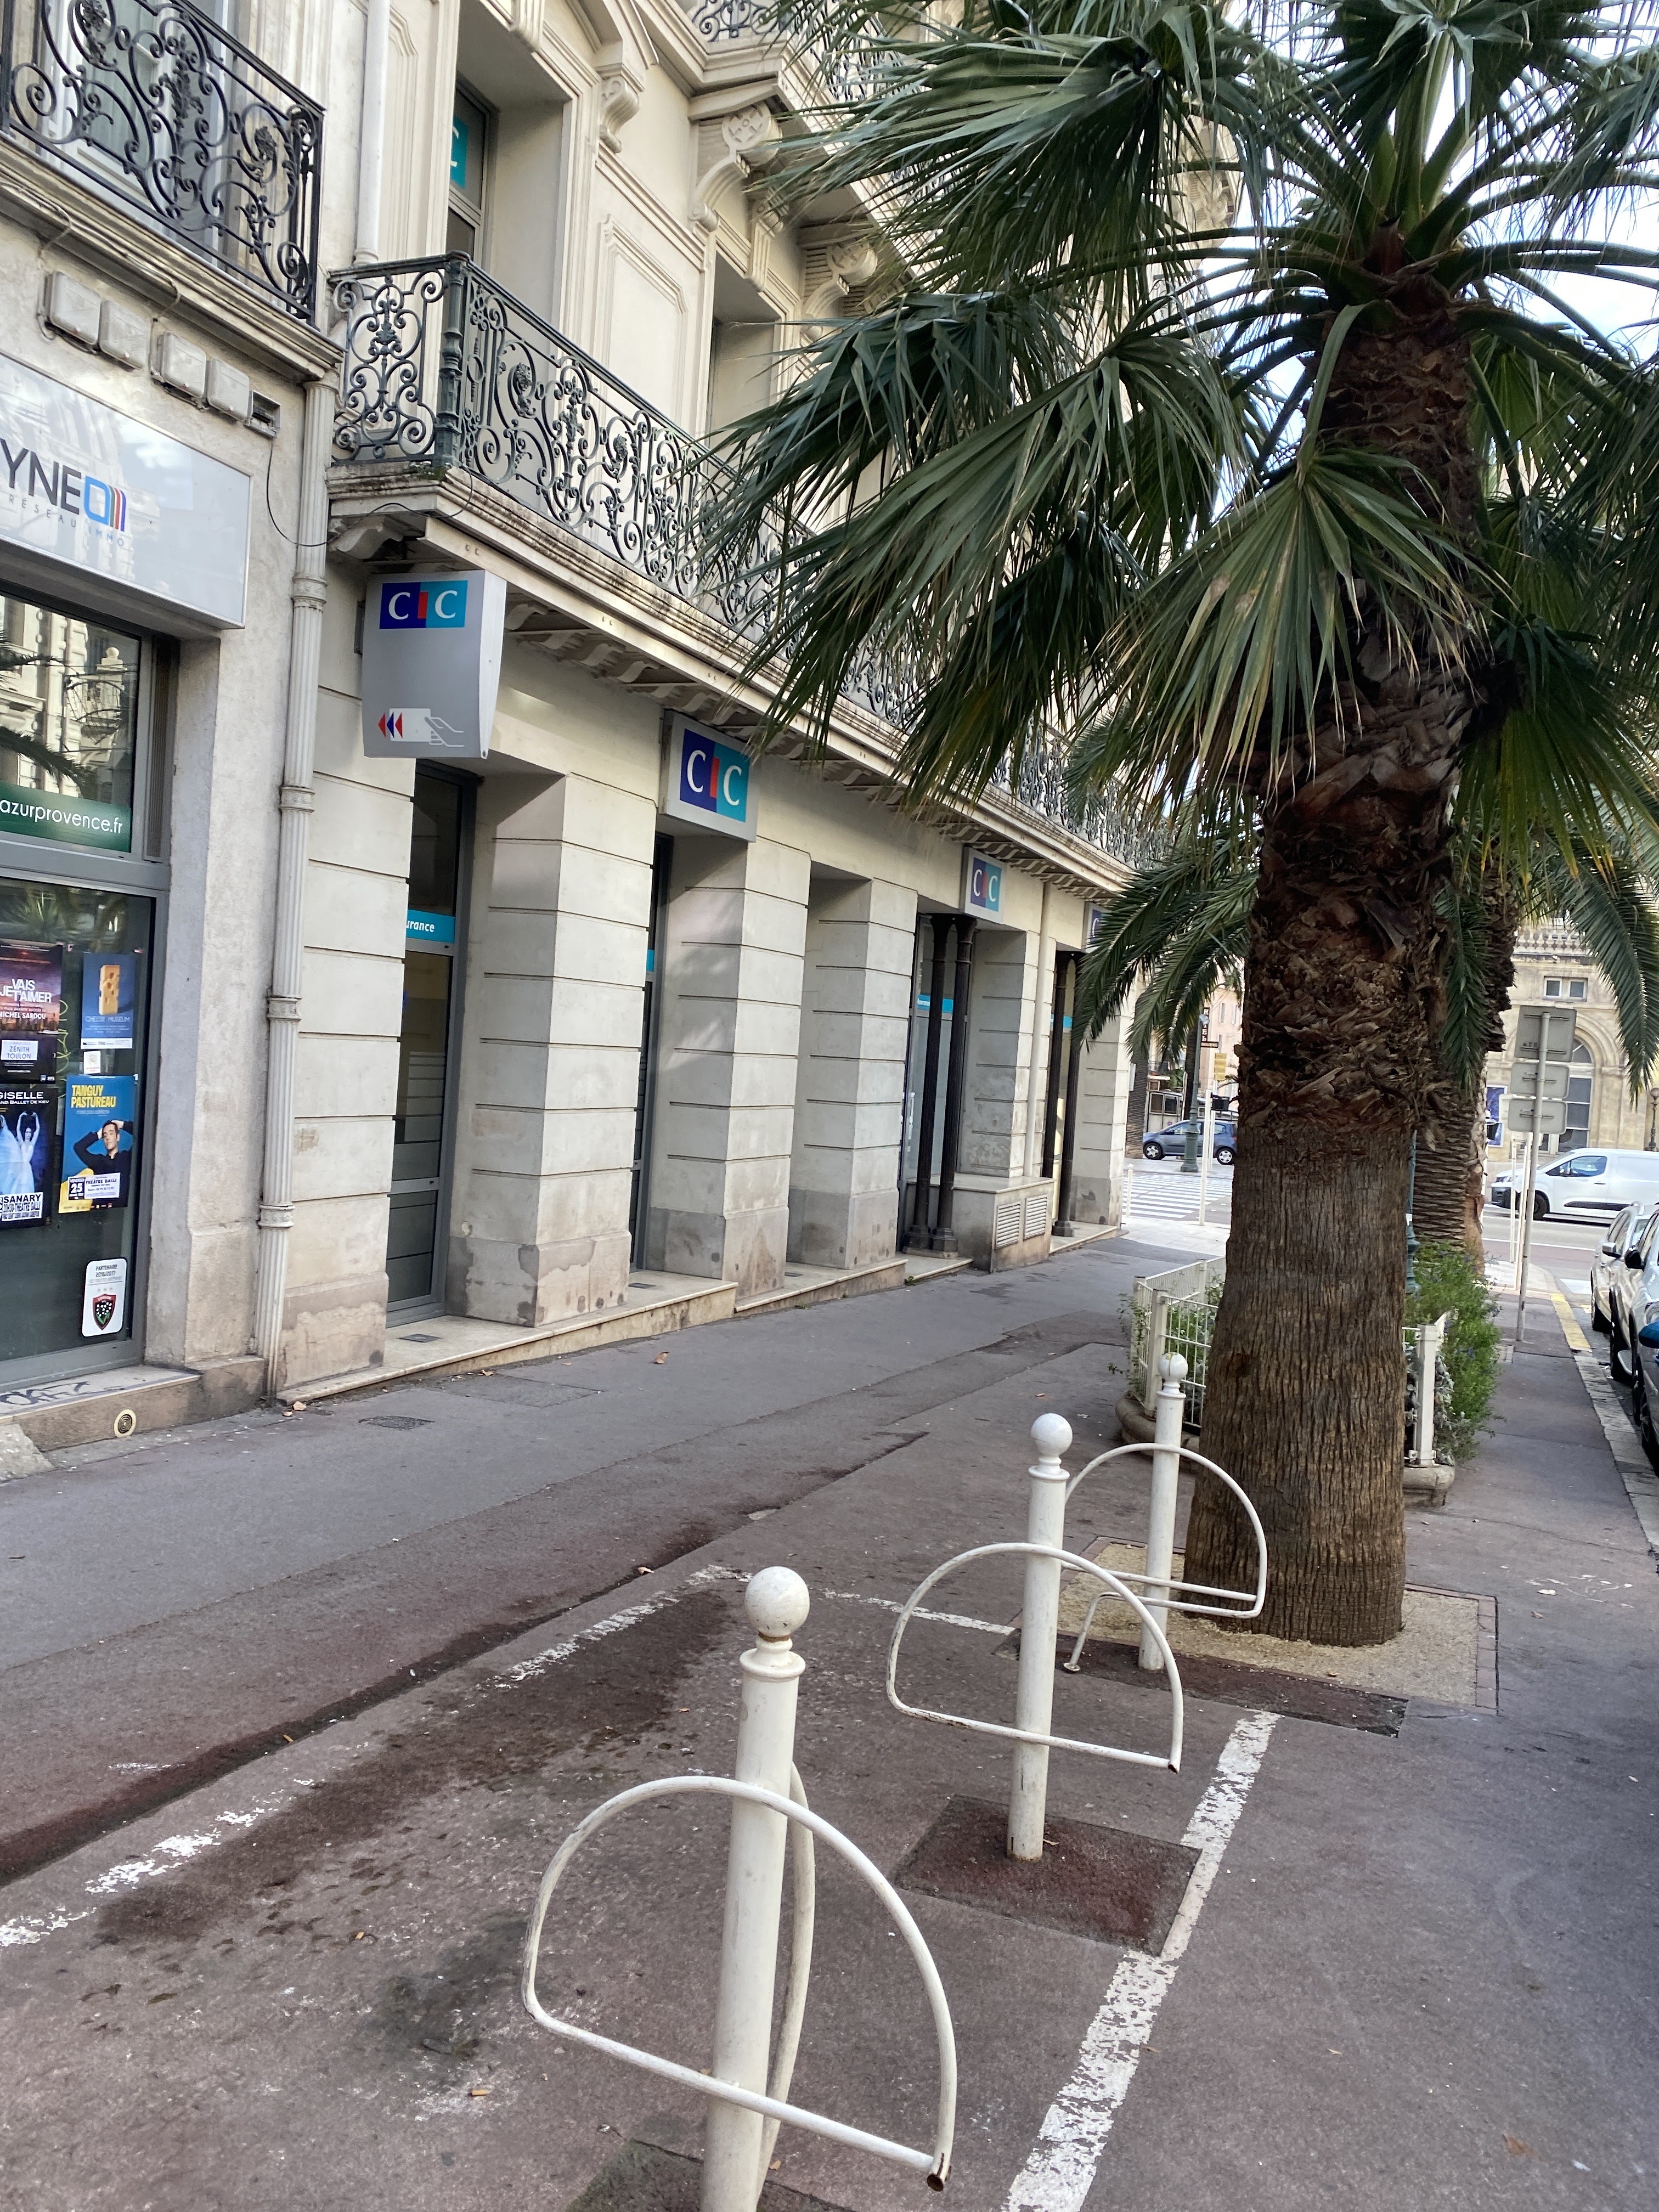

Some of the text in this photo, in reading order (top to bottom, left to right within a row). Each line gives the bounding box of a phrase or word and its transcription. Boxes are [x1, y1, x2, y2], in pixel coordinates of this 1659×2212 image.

[88, 526, 124, 546] IMMO
[388, 590, 458, 620] CIC
[687, 749, 742, 806] CIC
[0, 799, 122, 833] azurprovence.fr
[973, 869, 998, 902] CIC
[0, 985, 13, 997] JE
[12, 978, 35, 991] VAIS
[71, 1085, 104, 1096] TANGUY
[71, 1096, 116, 1108] PASTUREAU
[70, 1182, 83, 1194] 25
[4, 1194, 41, 1203] SANARY
